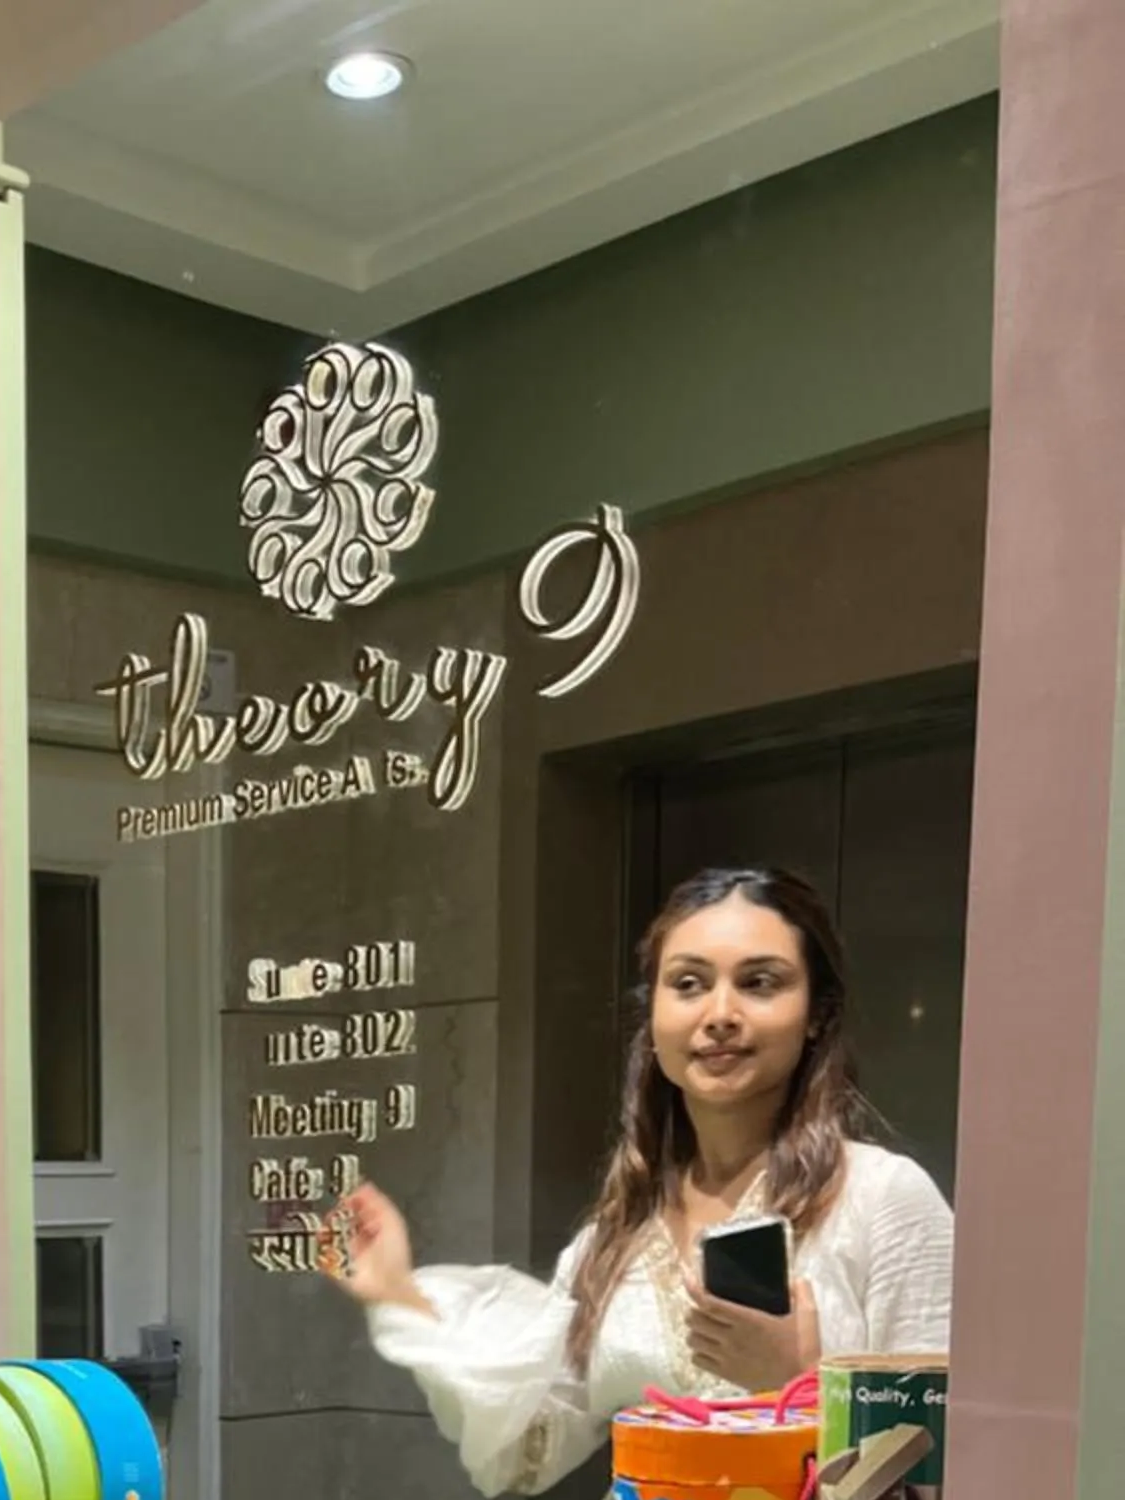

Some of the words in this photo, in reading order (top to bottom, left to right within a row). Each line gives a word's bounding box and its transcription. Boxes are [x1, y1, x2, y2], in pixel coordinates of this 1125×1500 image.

[95, 612, 505, 811] theory
[520, 502, 640, 697] 9
[117, 795, 227, 842] Premium
[232, 767, 335, 818] Service
[343, 941, 409, 990] 801
[341, 1010, 409, 1058] 802
[249, 1091, 369, 1141] Meeting
[384, 1085, 410, 1129] 9
[249, 1158, 317, 1202] Cafe
[329, 1155, 352, 1197] 9
[855, 1386, 915, 1408] Quality,
